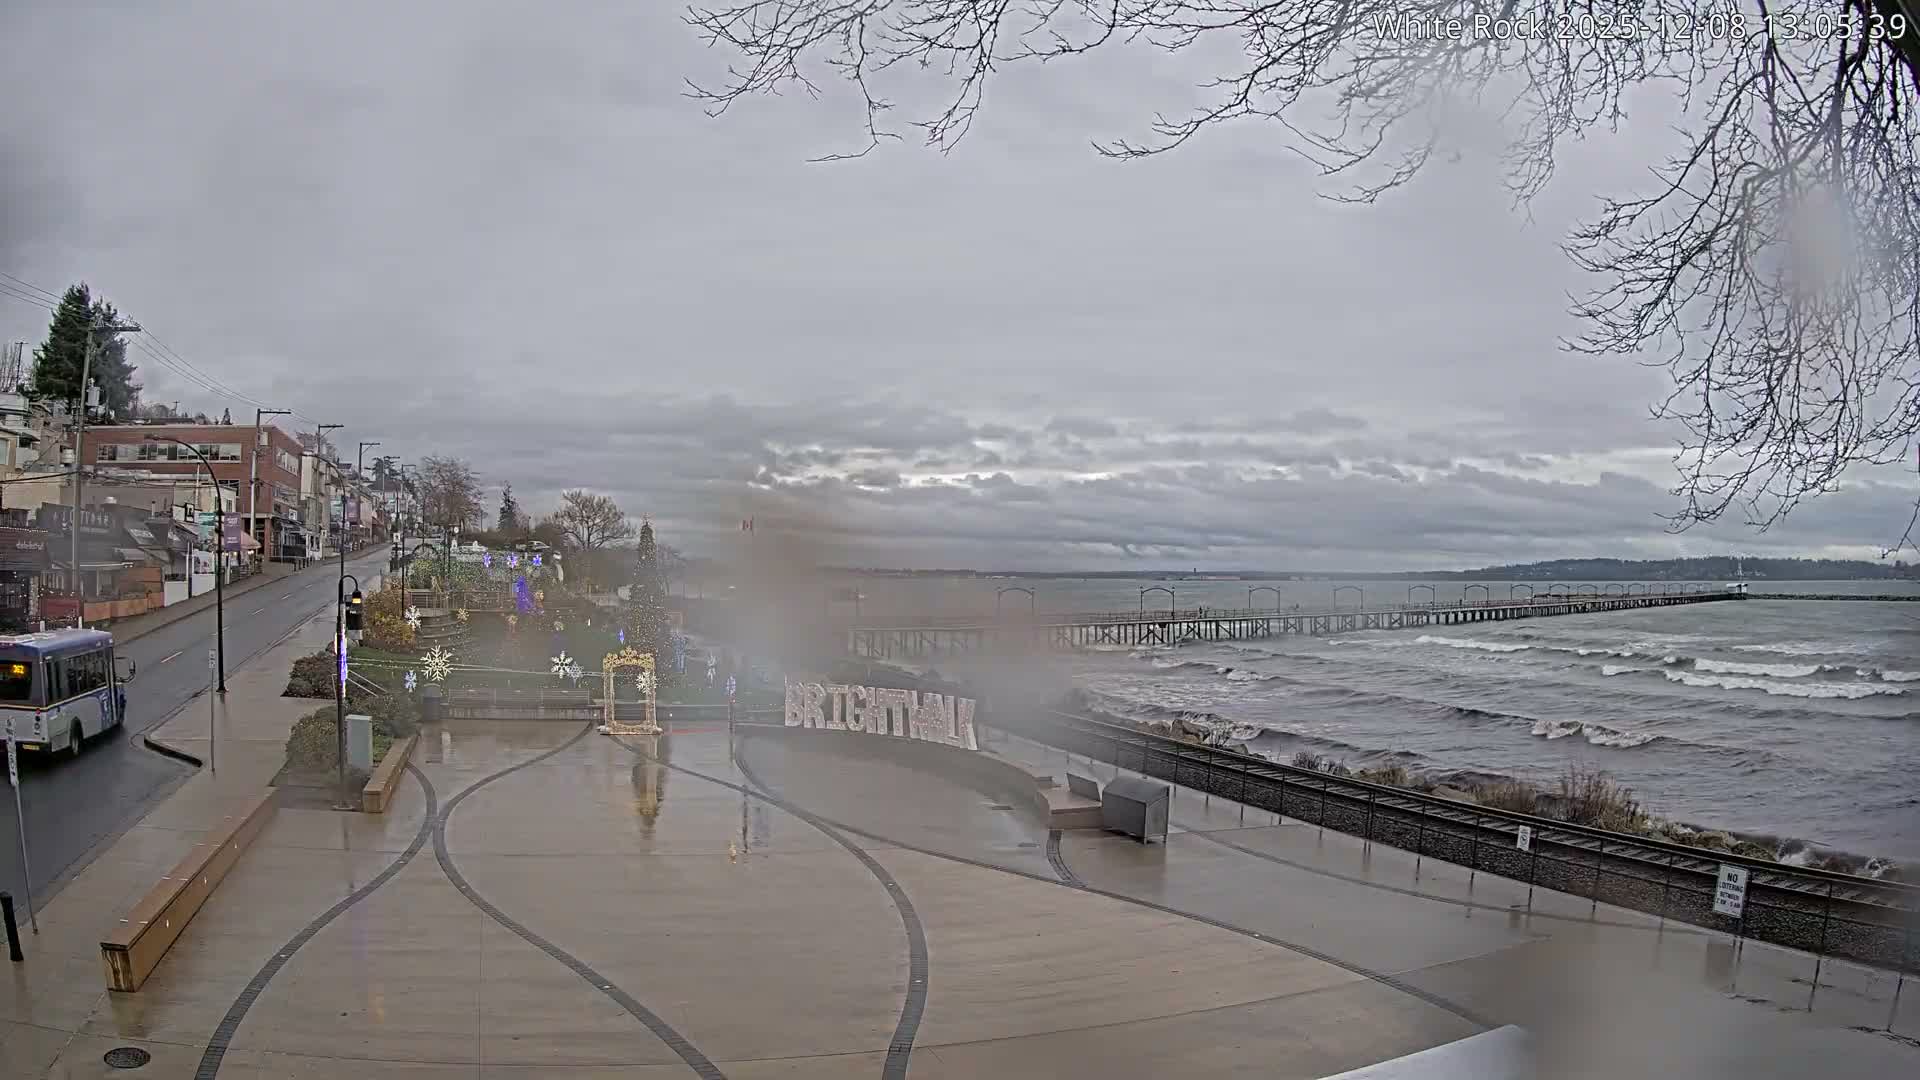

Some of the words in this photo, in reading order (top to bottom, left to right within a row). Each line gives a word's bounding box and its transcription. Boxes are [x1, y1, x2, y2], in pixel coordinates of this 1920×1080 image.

[785, 682, 978, 750] BRIGHTWALK
[1727, 873, 1738, 883] NO
[1719, 882, 1743, 893] LOITERING
